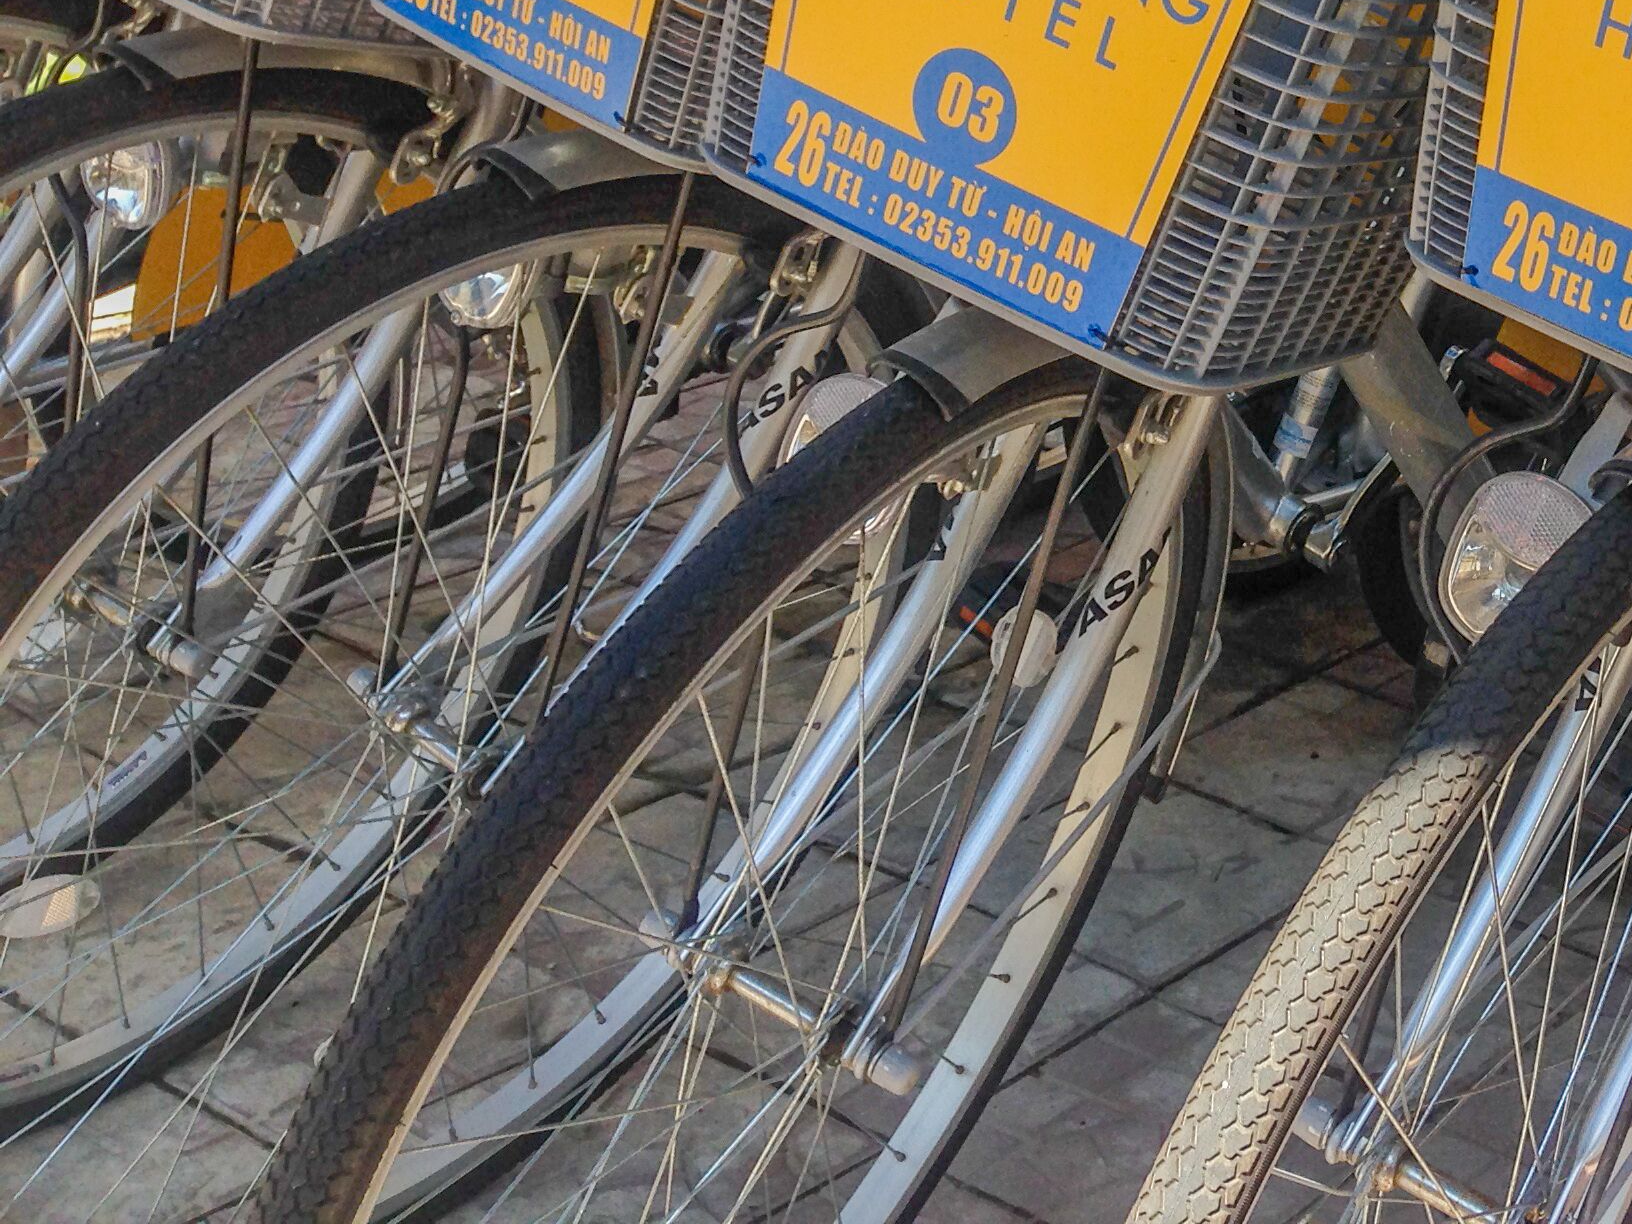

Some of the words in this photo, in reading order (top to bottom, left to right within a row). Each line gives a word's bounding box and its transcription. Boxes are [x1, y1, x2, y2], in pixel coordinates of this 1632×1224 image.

[470, 10, 606, 100] 02353.911.009
[584, 29, 612, 64] AN
[773, 99, 832, 187] 26
[937, 71, 1005, 143] 03
[822, 162, 864, 208] TEL
[883, 193, 1084, 313] 02353.911.009
[888, 149, 944, 199] DUY
[1055, 230, 1096, 272] AN
[1491, 200, 1555, 292] 26
[1549, 263, 1595, 314] TEL
